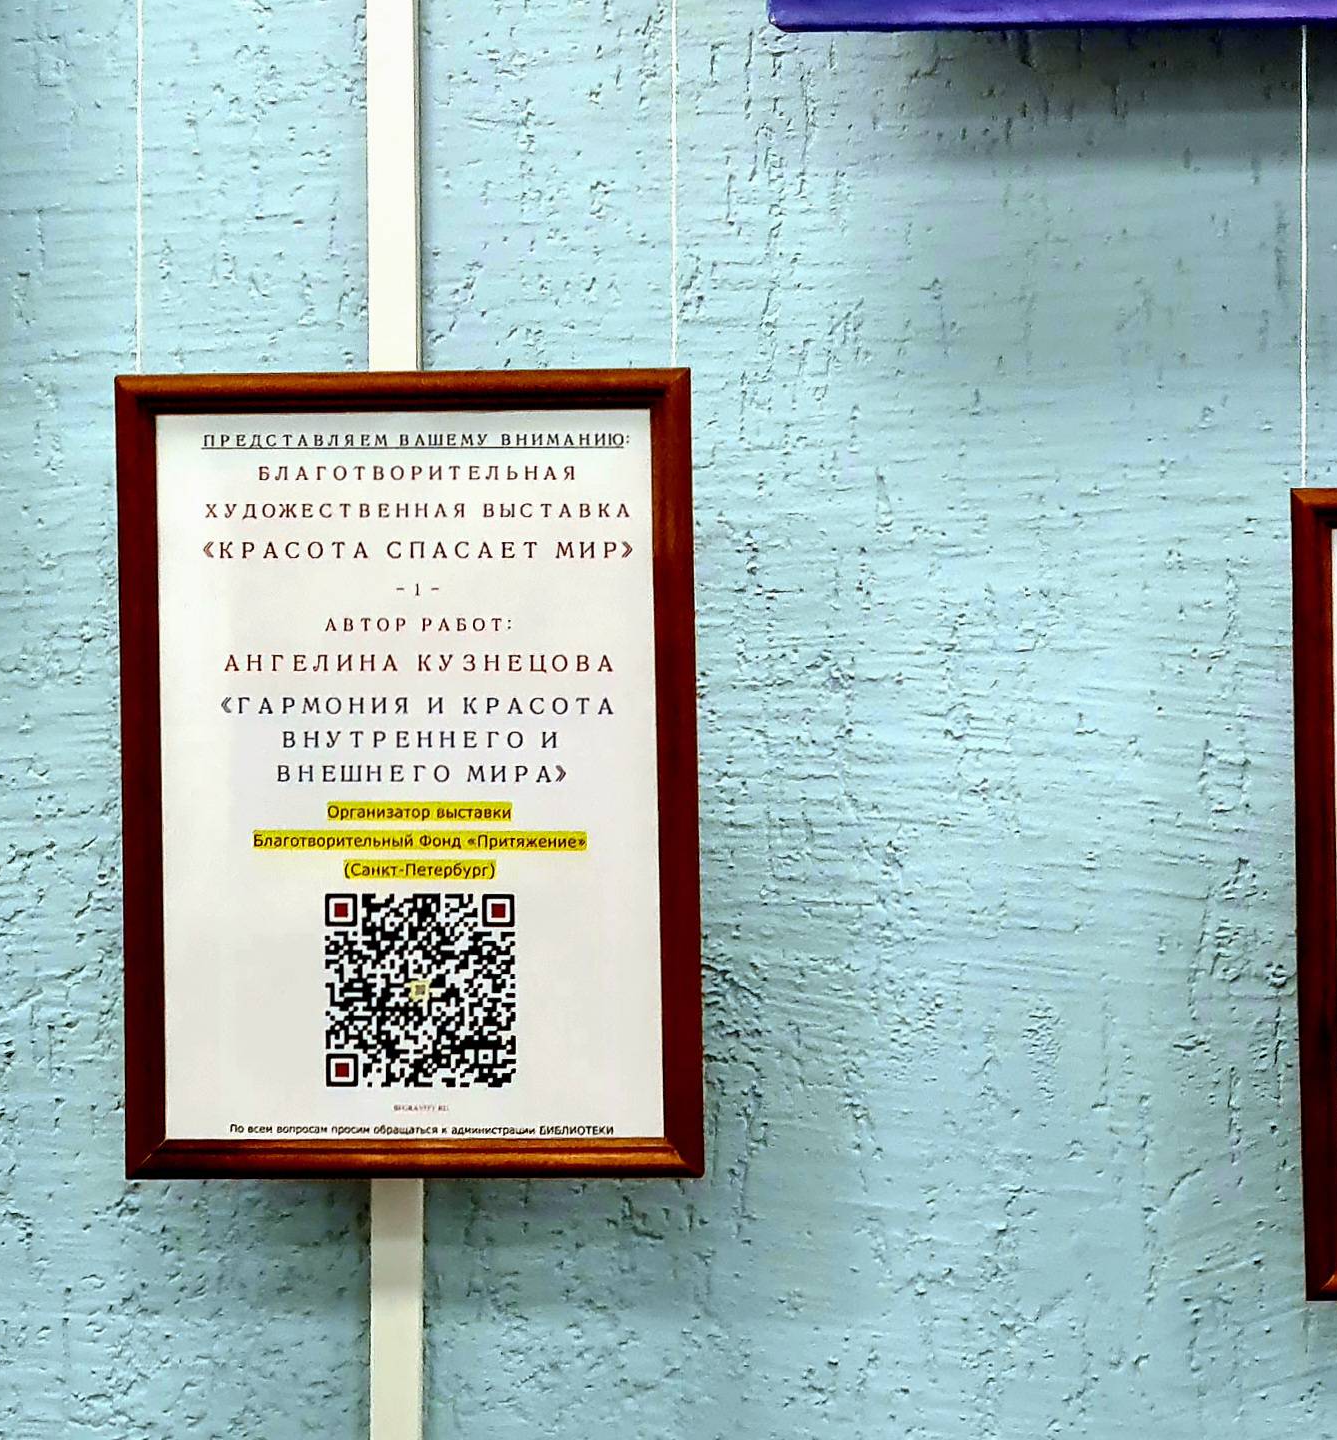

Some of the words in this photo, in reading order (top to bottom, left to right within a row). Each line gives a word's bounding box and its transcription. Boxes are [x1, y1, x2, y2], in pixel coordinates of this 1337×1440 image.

[203, 433, 389, 449] ПРЕДСТАВЛЯЕМ
[400, 433, 488, 447] ВАШЕМУ
[502, 433, 630, 448] ВНИМАНИЮ:
[259, 465, 575, 481] БЛАГОТВОРИТЕЛЬНАЯ
[205, 502, 465, 520] ХУДОЖЕСТВЕННАЯ
[483, 502, 630, 519] ВЫСТАВКА
[387, 541, 537, 560] СПАСАЕТ
[415, 582, 420, 597] 1
[325, 617, 406, 633] АВТОР
[422, 617, 511, 632] РАБОТ:
[224, 653, 398, 672] АНГЕЛИНА
[418, 653, 613, 674] КУЗНЕЦОВА
[428, 697, 443, 715] И
[463, 697, 613, 716] КРАСОТА
[283, 730, 523, 749] ВНУТРЕННЕГО
[541, 731, 557, 749] И
[277, 764, 450, 783] ВНЕШНЕГО
[327, 806, 430, 821] Организатор
[437, 808, 511, 820] выставки
[253, 834, 414, 850] Благотворительный
[419, 835, 462, 850] Фонд
[343, 863, 496, 880] (Санкт-Петербург)
